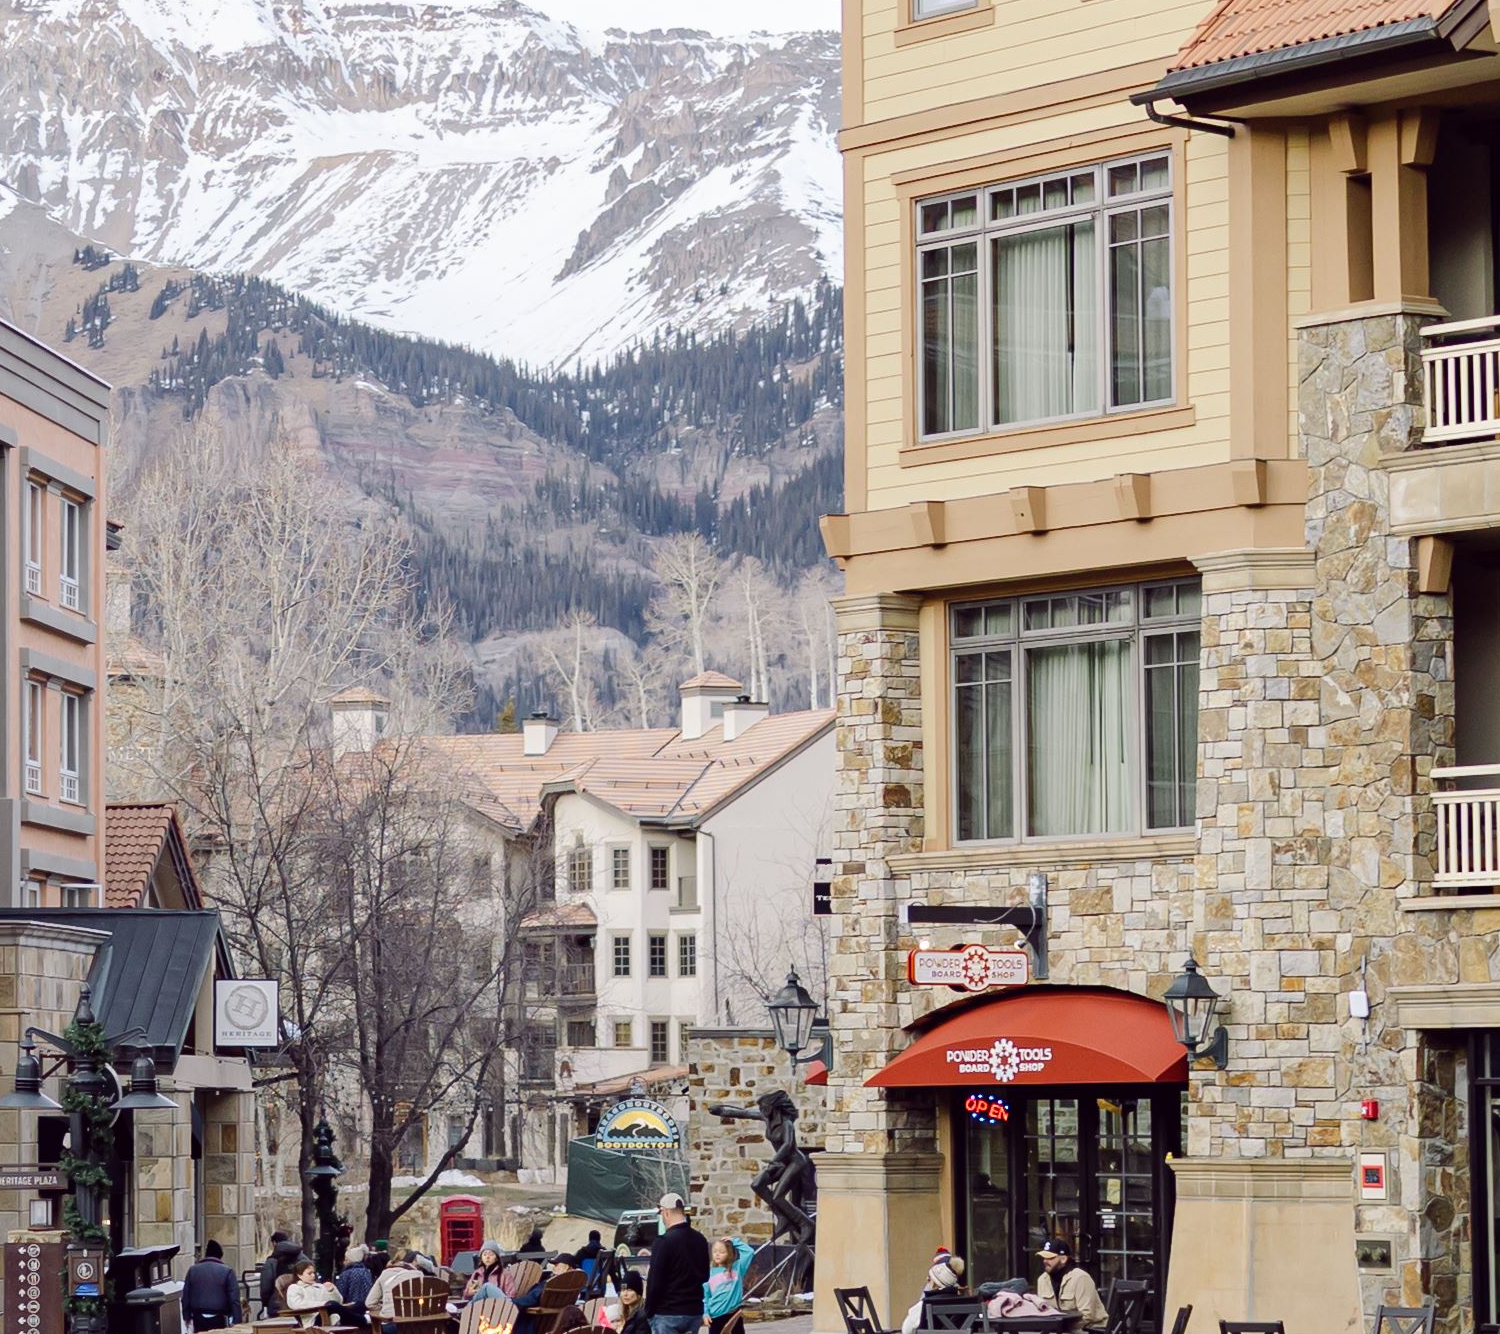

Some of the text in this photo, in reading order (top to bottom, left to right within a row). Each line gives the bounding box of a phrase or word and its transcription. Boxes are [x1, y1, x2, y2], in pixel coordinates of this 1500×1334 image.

[919, 958, 1022, 969] POWDER TOOLS
[946, 1048, 1052, 1063] POWDER TOOLS
[959, 1063, 1045, 1073] BOARD SHOP
[965, 1098, 1009, 1122] OPEN
[34, 1175, 58, 1185] PLAZA
